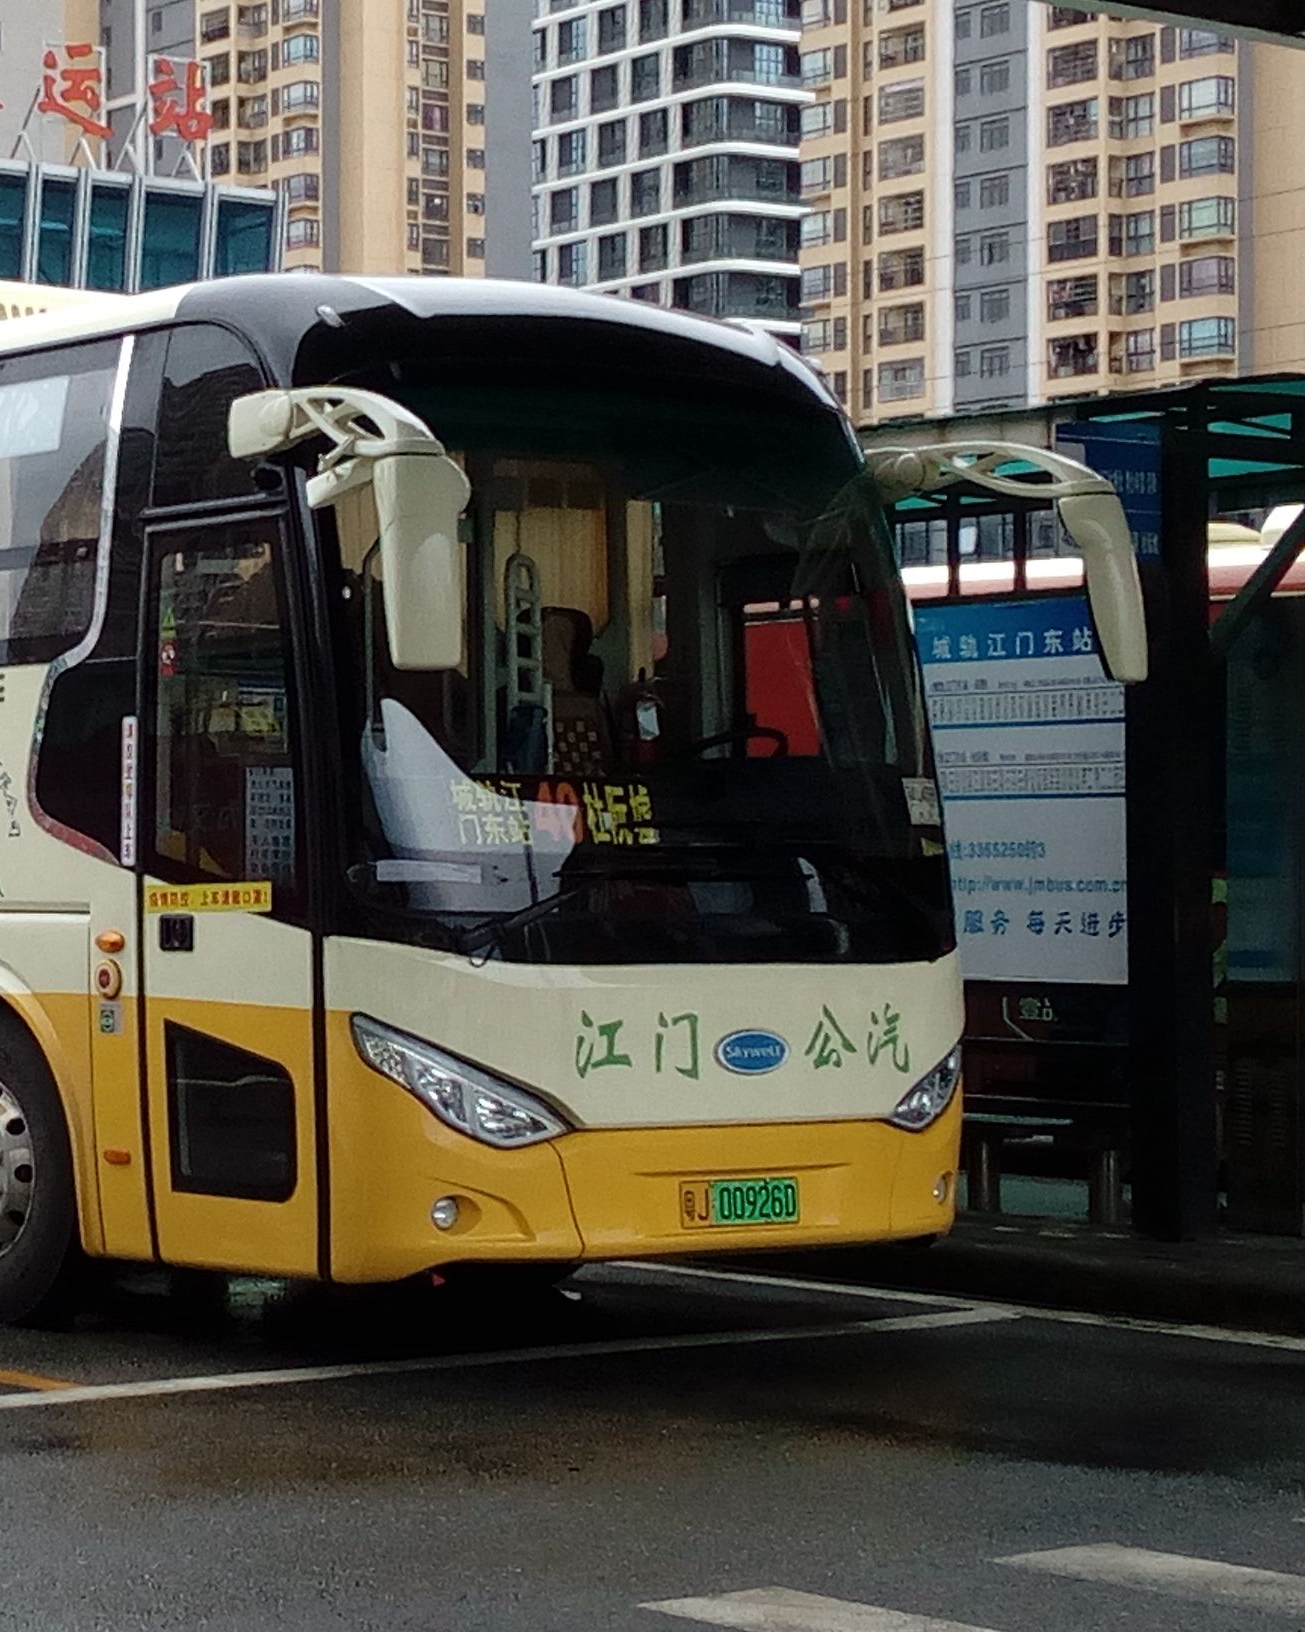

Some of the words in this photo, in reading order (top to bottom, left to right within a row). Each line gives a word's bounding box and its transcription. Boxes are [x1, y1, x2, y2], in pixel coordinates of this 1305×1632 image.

[963, 909, 1010, 935] 服务
[575, 1008, 700, 1080] 江门
[804, 1002, 910, 1074] 公汽
